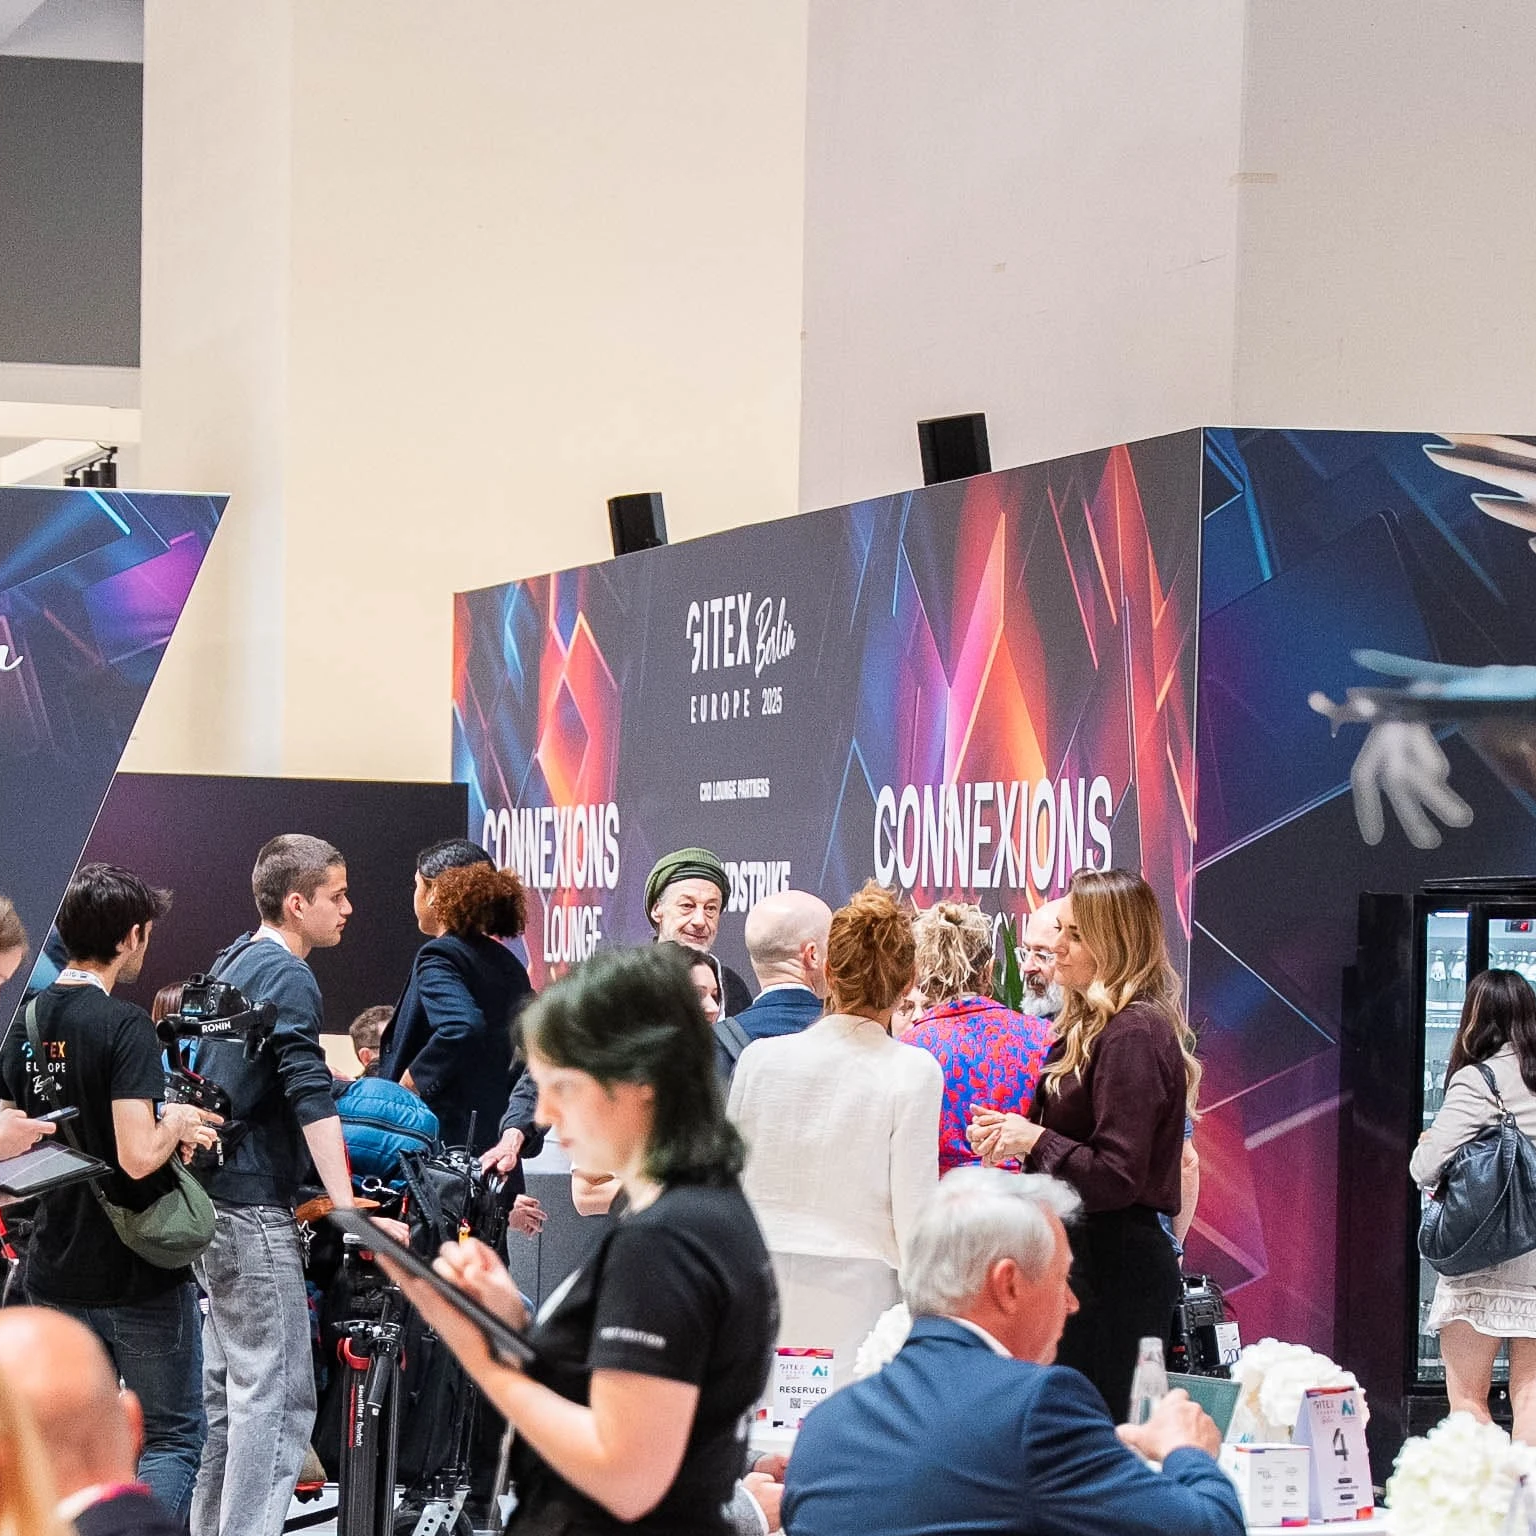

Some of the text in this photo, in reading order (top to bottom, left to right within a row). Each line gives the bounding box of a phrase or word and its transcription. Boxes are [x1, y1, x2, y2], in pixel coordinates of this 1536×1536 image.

[686, 592, 751, 673] GITEX
[691, 687, 782, 723] EUROPE 2025
[482, 802, 620, 890] CONNEXIONS
[873, 775, 1114, 890] CONNEXIONS
[544, 905, 603, 962] LOUNGE
[202, 1021, 231, 1033] RONIN
[779, 1386, 827, 1394] RESERVED
[1332, 1427, 1349, 1461] 4
